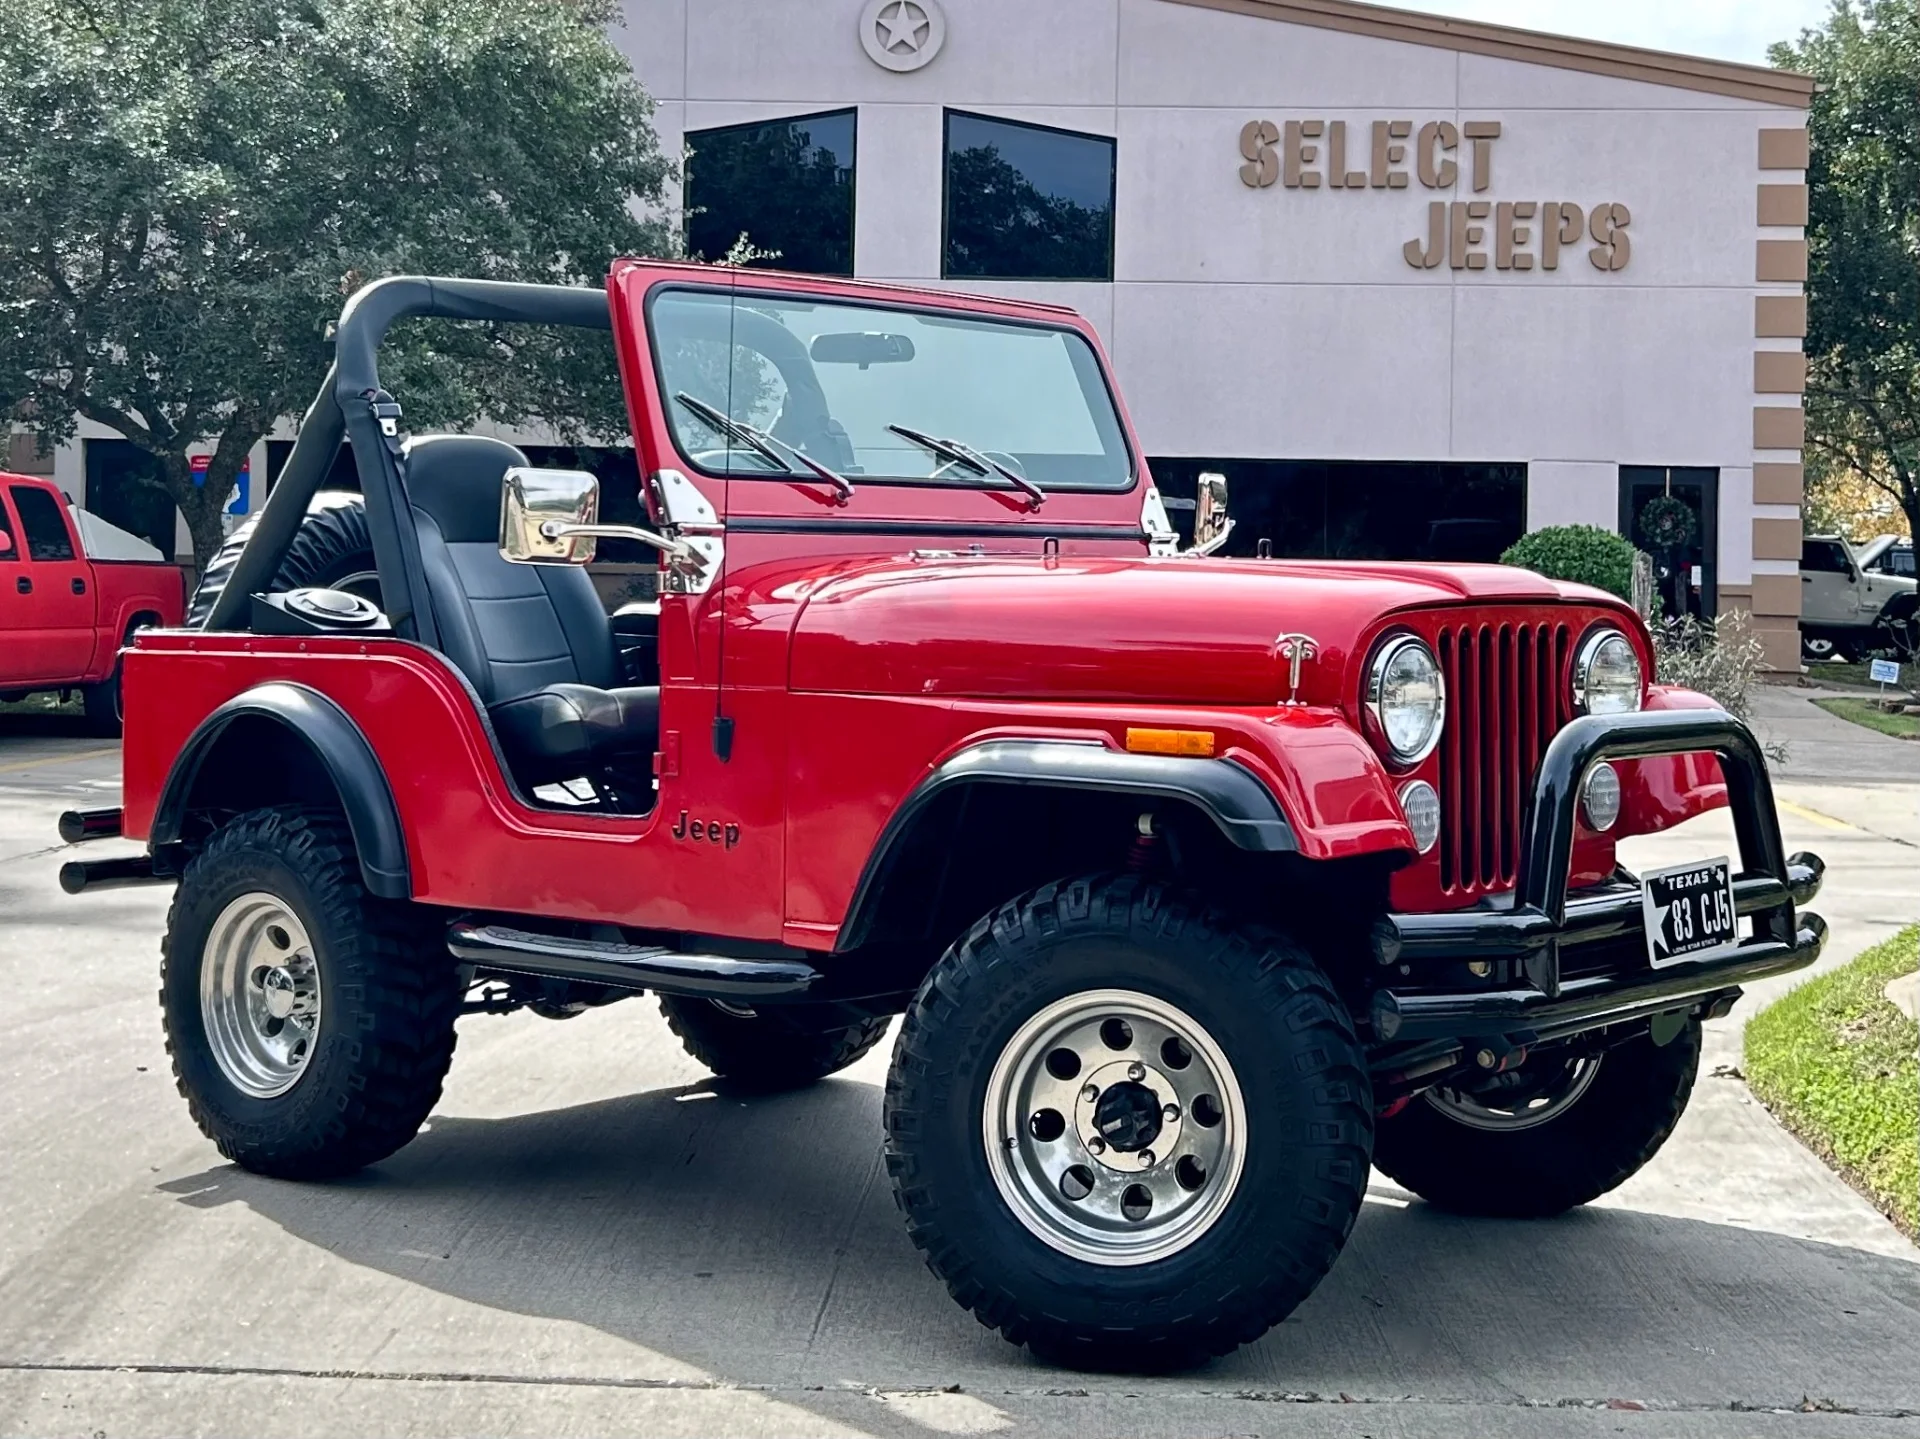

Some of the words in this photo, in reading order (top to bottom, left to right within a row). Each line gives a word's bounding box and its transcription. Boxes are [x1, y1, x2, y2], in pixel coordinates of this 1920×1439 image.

[1239, 119, 1501, 192] SELECT
[1403, 201, 1631, 271] JEEPS
[672, 809, 740, 850] Jeep
[1667, 870, 1709, 890] TEXAS
[1672, 897, 1693, 941] 83
[1701, 889, 1731, 934] CJ5
